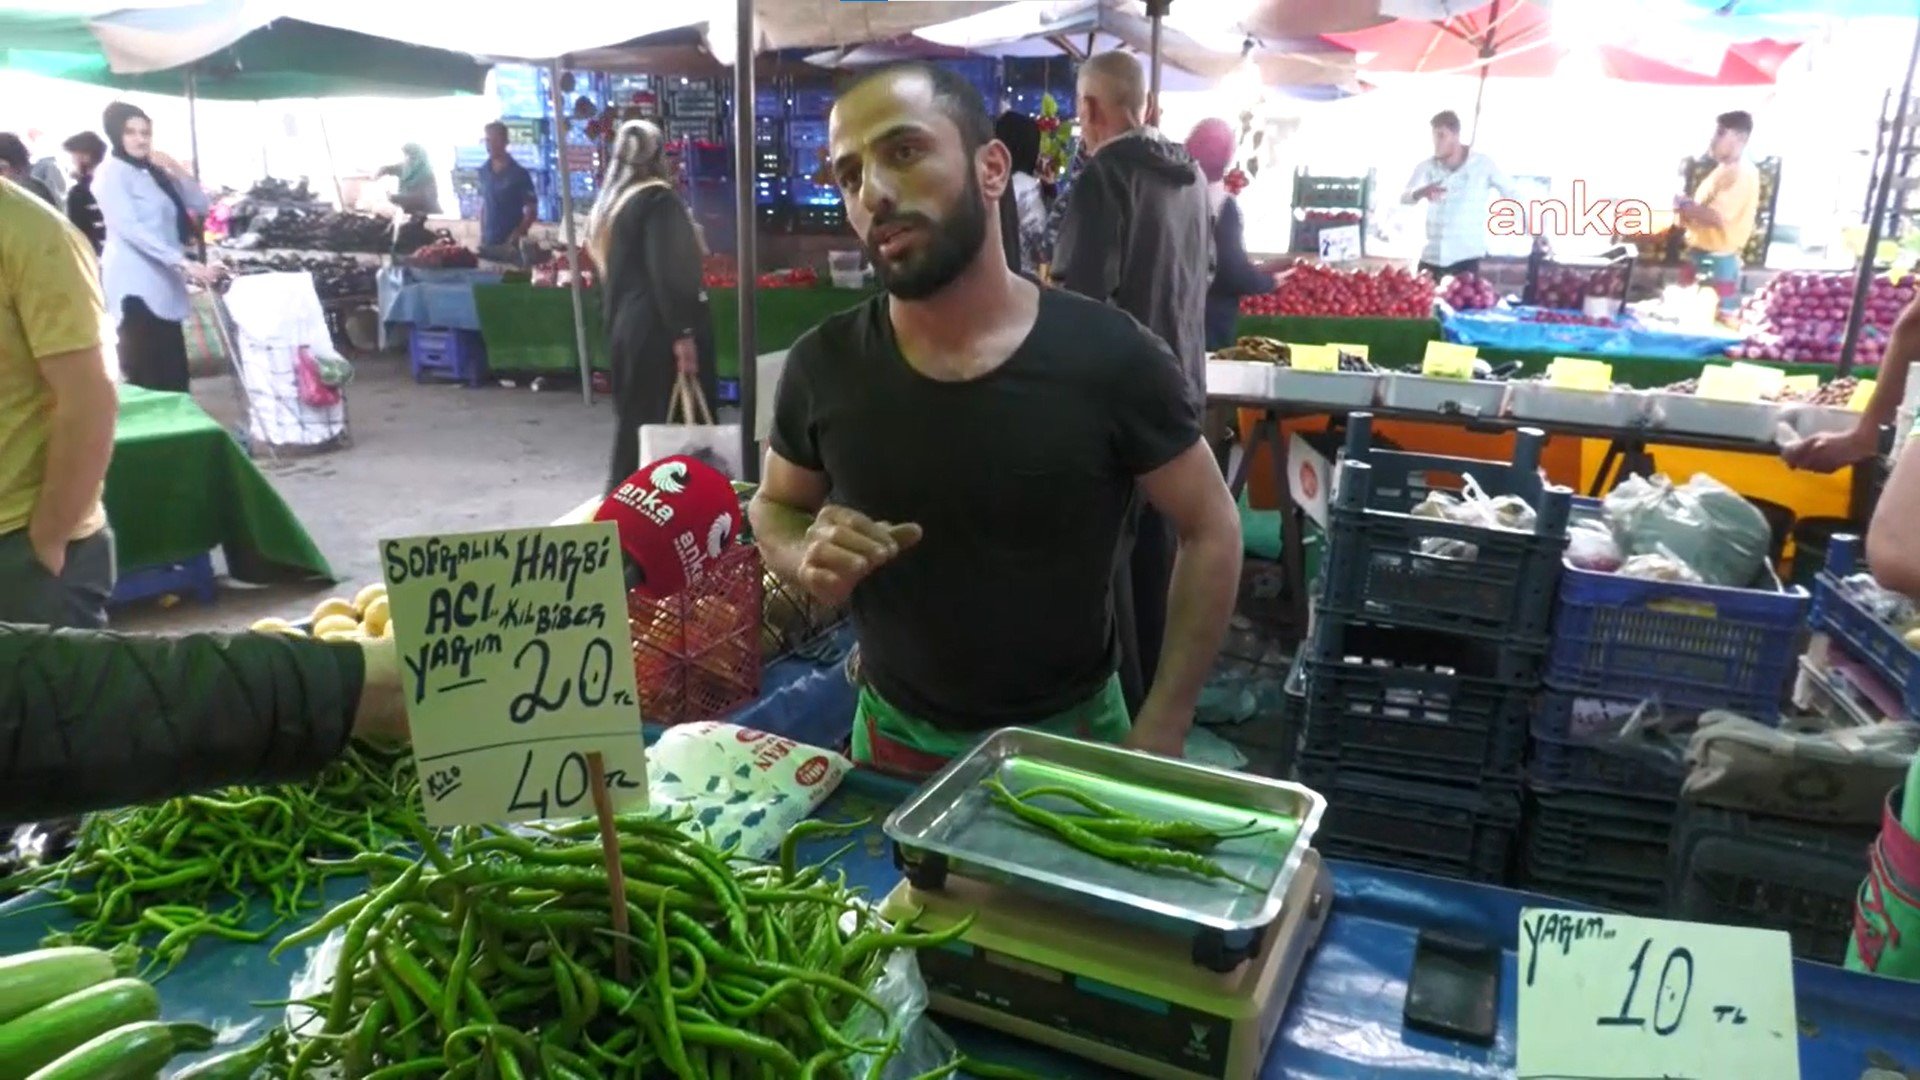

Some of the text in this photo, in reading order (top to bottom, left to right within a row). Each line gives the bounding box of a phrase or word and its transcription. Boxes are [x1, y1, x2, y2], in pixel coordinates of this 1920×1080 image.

[618, 483, 674, 521] anka
[385, 533, 510, 584] SOFRALIK
[404, 634, 634, 724] YARIM 20 TL
[507, 750, 589, 819] 40
[603, 769, 641, 789] TL
[1597, 937, 1695, 1036] 10
